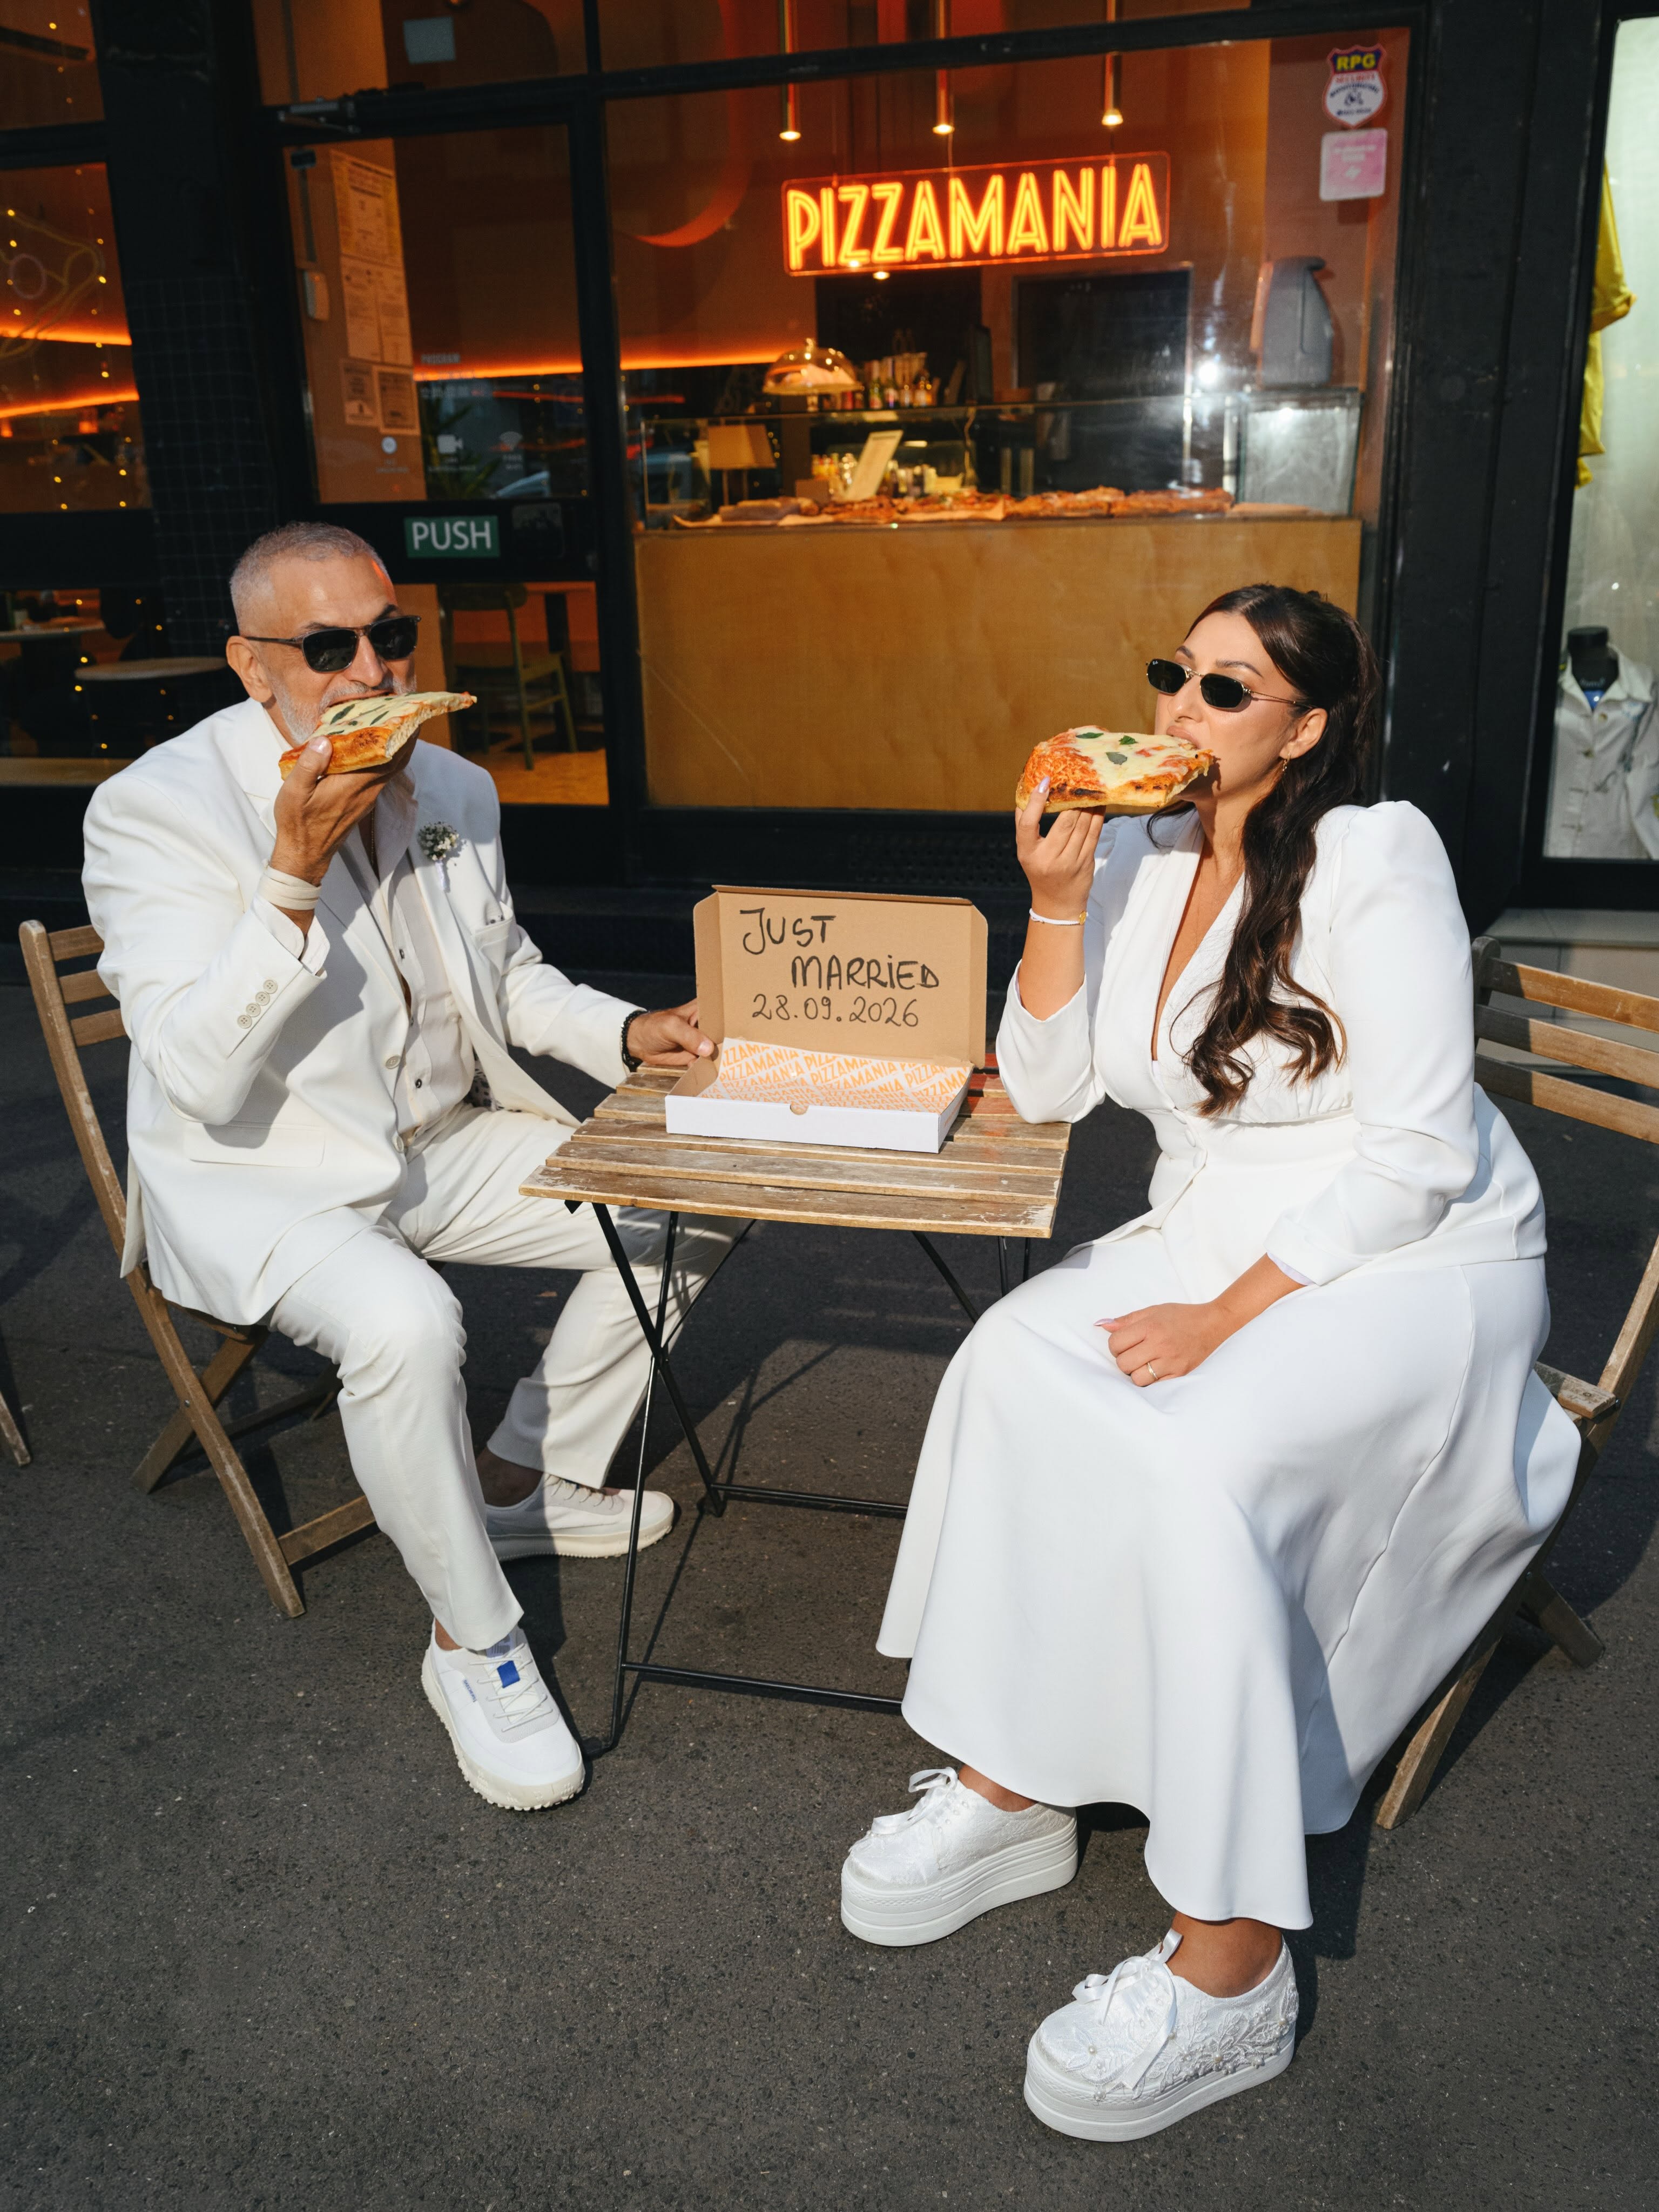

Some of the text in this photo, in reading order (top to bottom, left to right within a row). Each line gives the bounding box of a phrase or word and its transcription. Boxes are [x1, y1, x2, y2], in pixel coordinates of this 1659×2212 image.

[1337, 53, 1375, 70] RPG
[786, 163, 1162, 270] PIZZAMANIA
[412, 521, 491, 550] PUSH
[739, 907, 837, 955] JUST
[752, 993, 919, 1027] 28.09.2026
[719, 1048, 800, 1082] PIZZAMANIA
[722, 1060, 805, 1089] PIZZAMANIA
[817, 1062, 898, 1090] PIZZAMANIA
